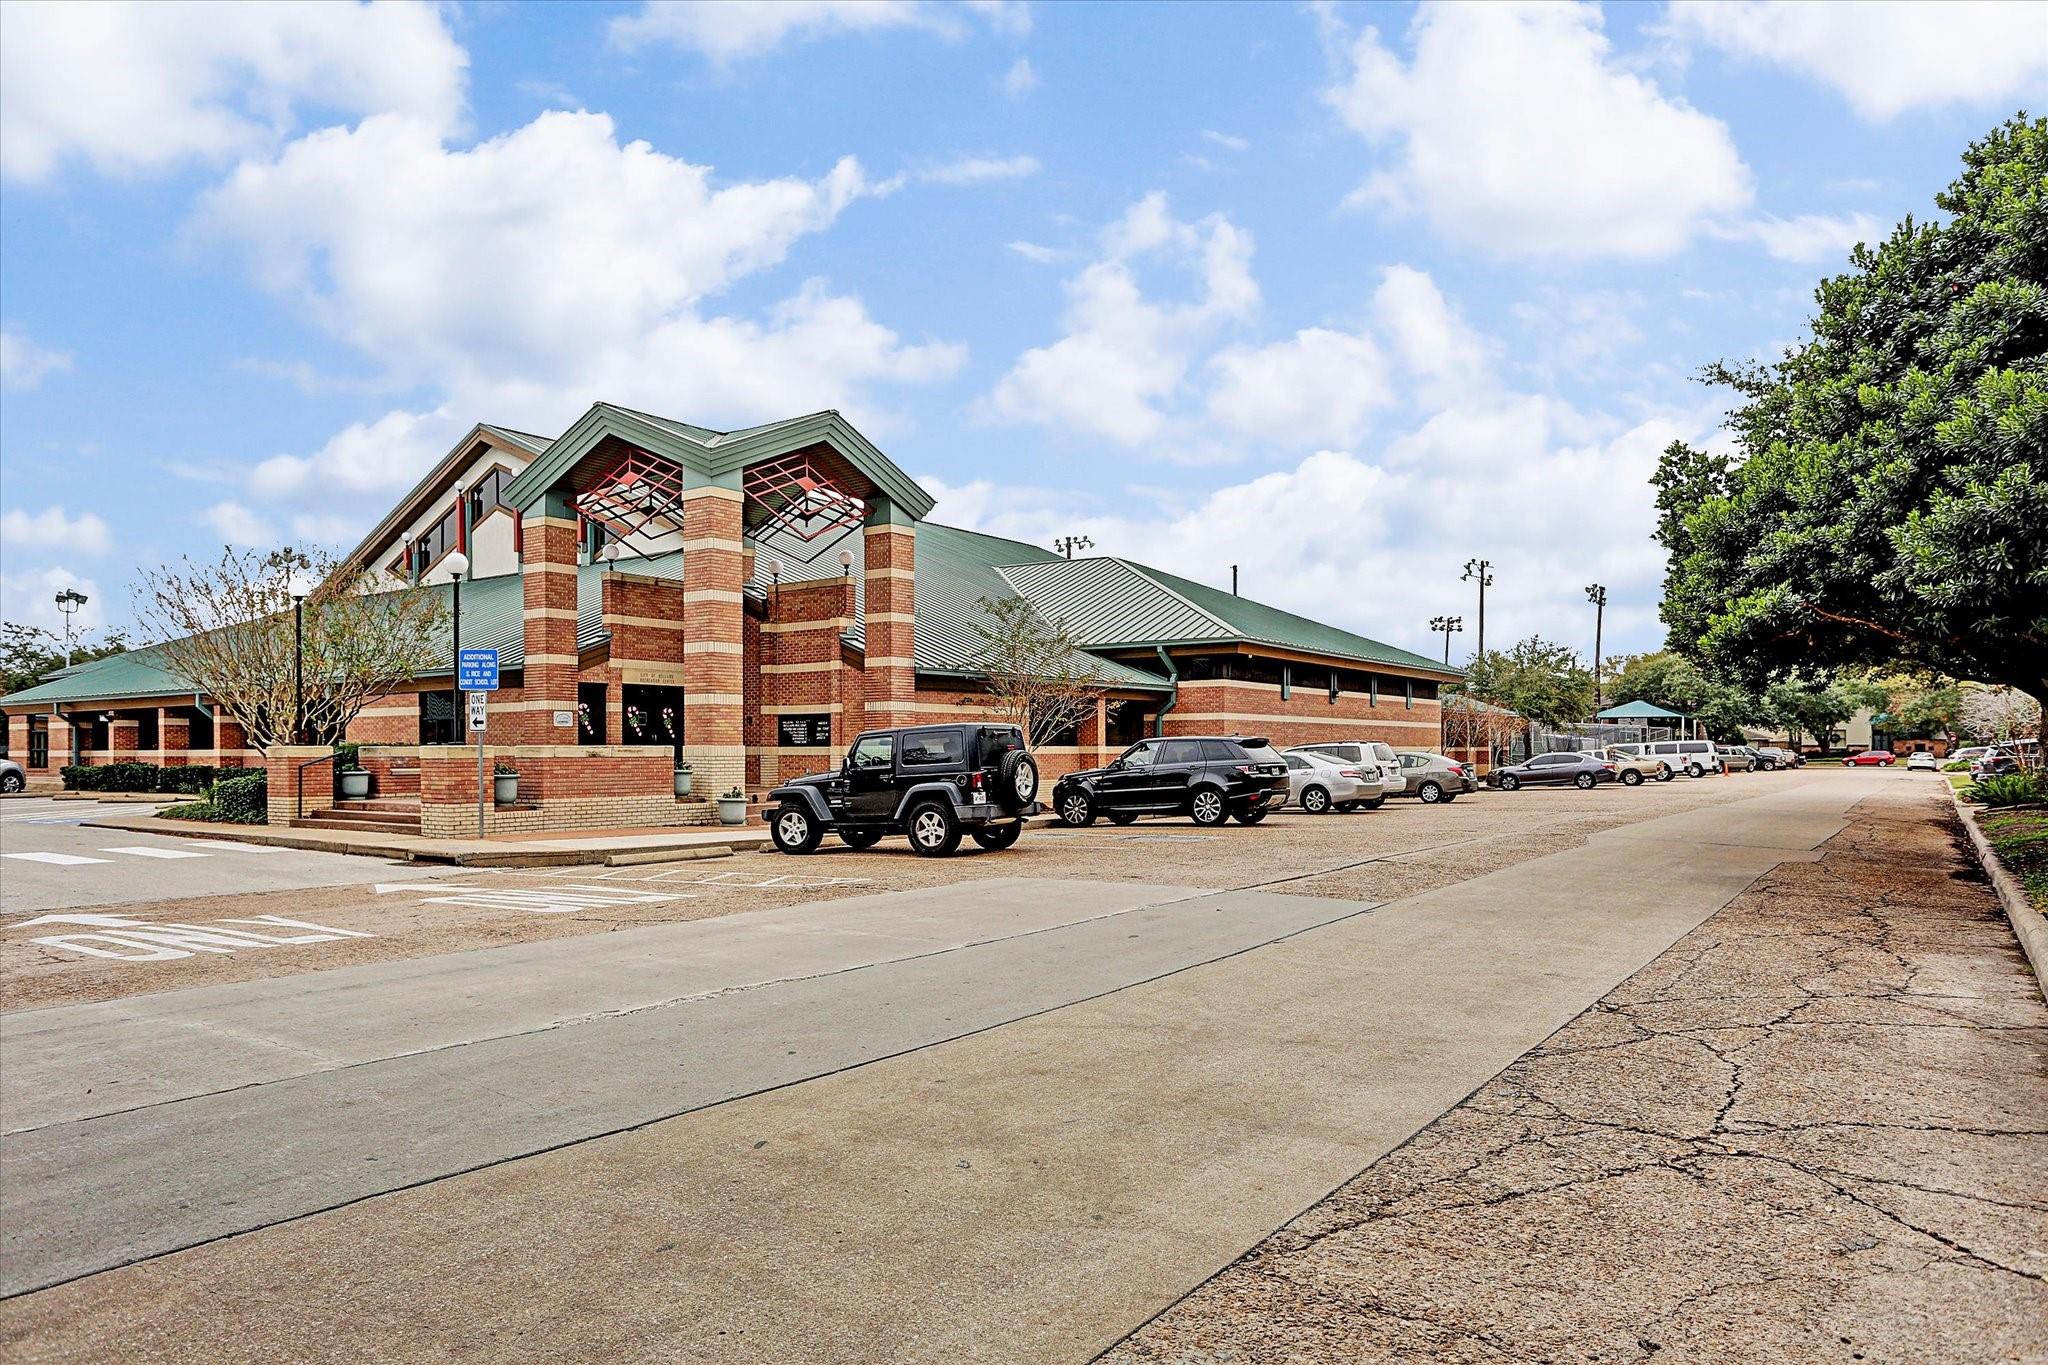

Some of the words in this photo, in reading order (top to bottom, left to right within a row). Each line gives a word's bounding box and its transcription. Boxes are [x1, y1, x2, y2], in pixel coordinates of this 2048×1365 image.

[471, 695, 484, 704] ONE
[471, 706, 484, 715] WAY
[29, 914, 378, 961] ONLY
